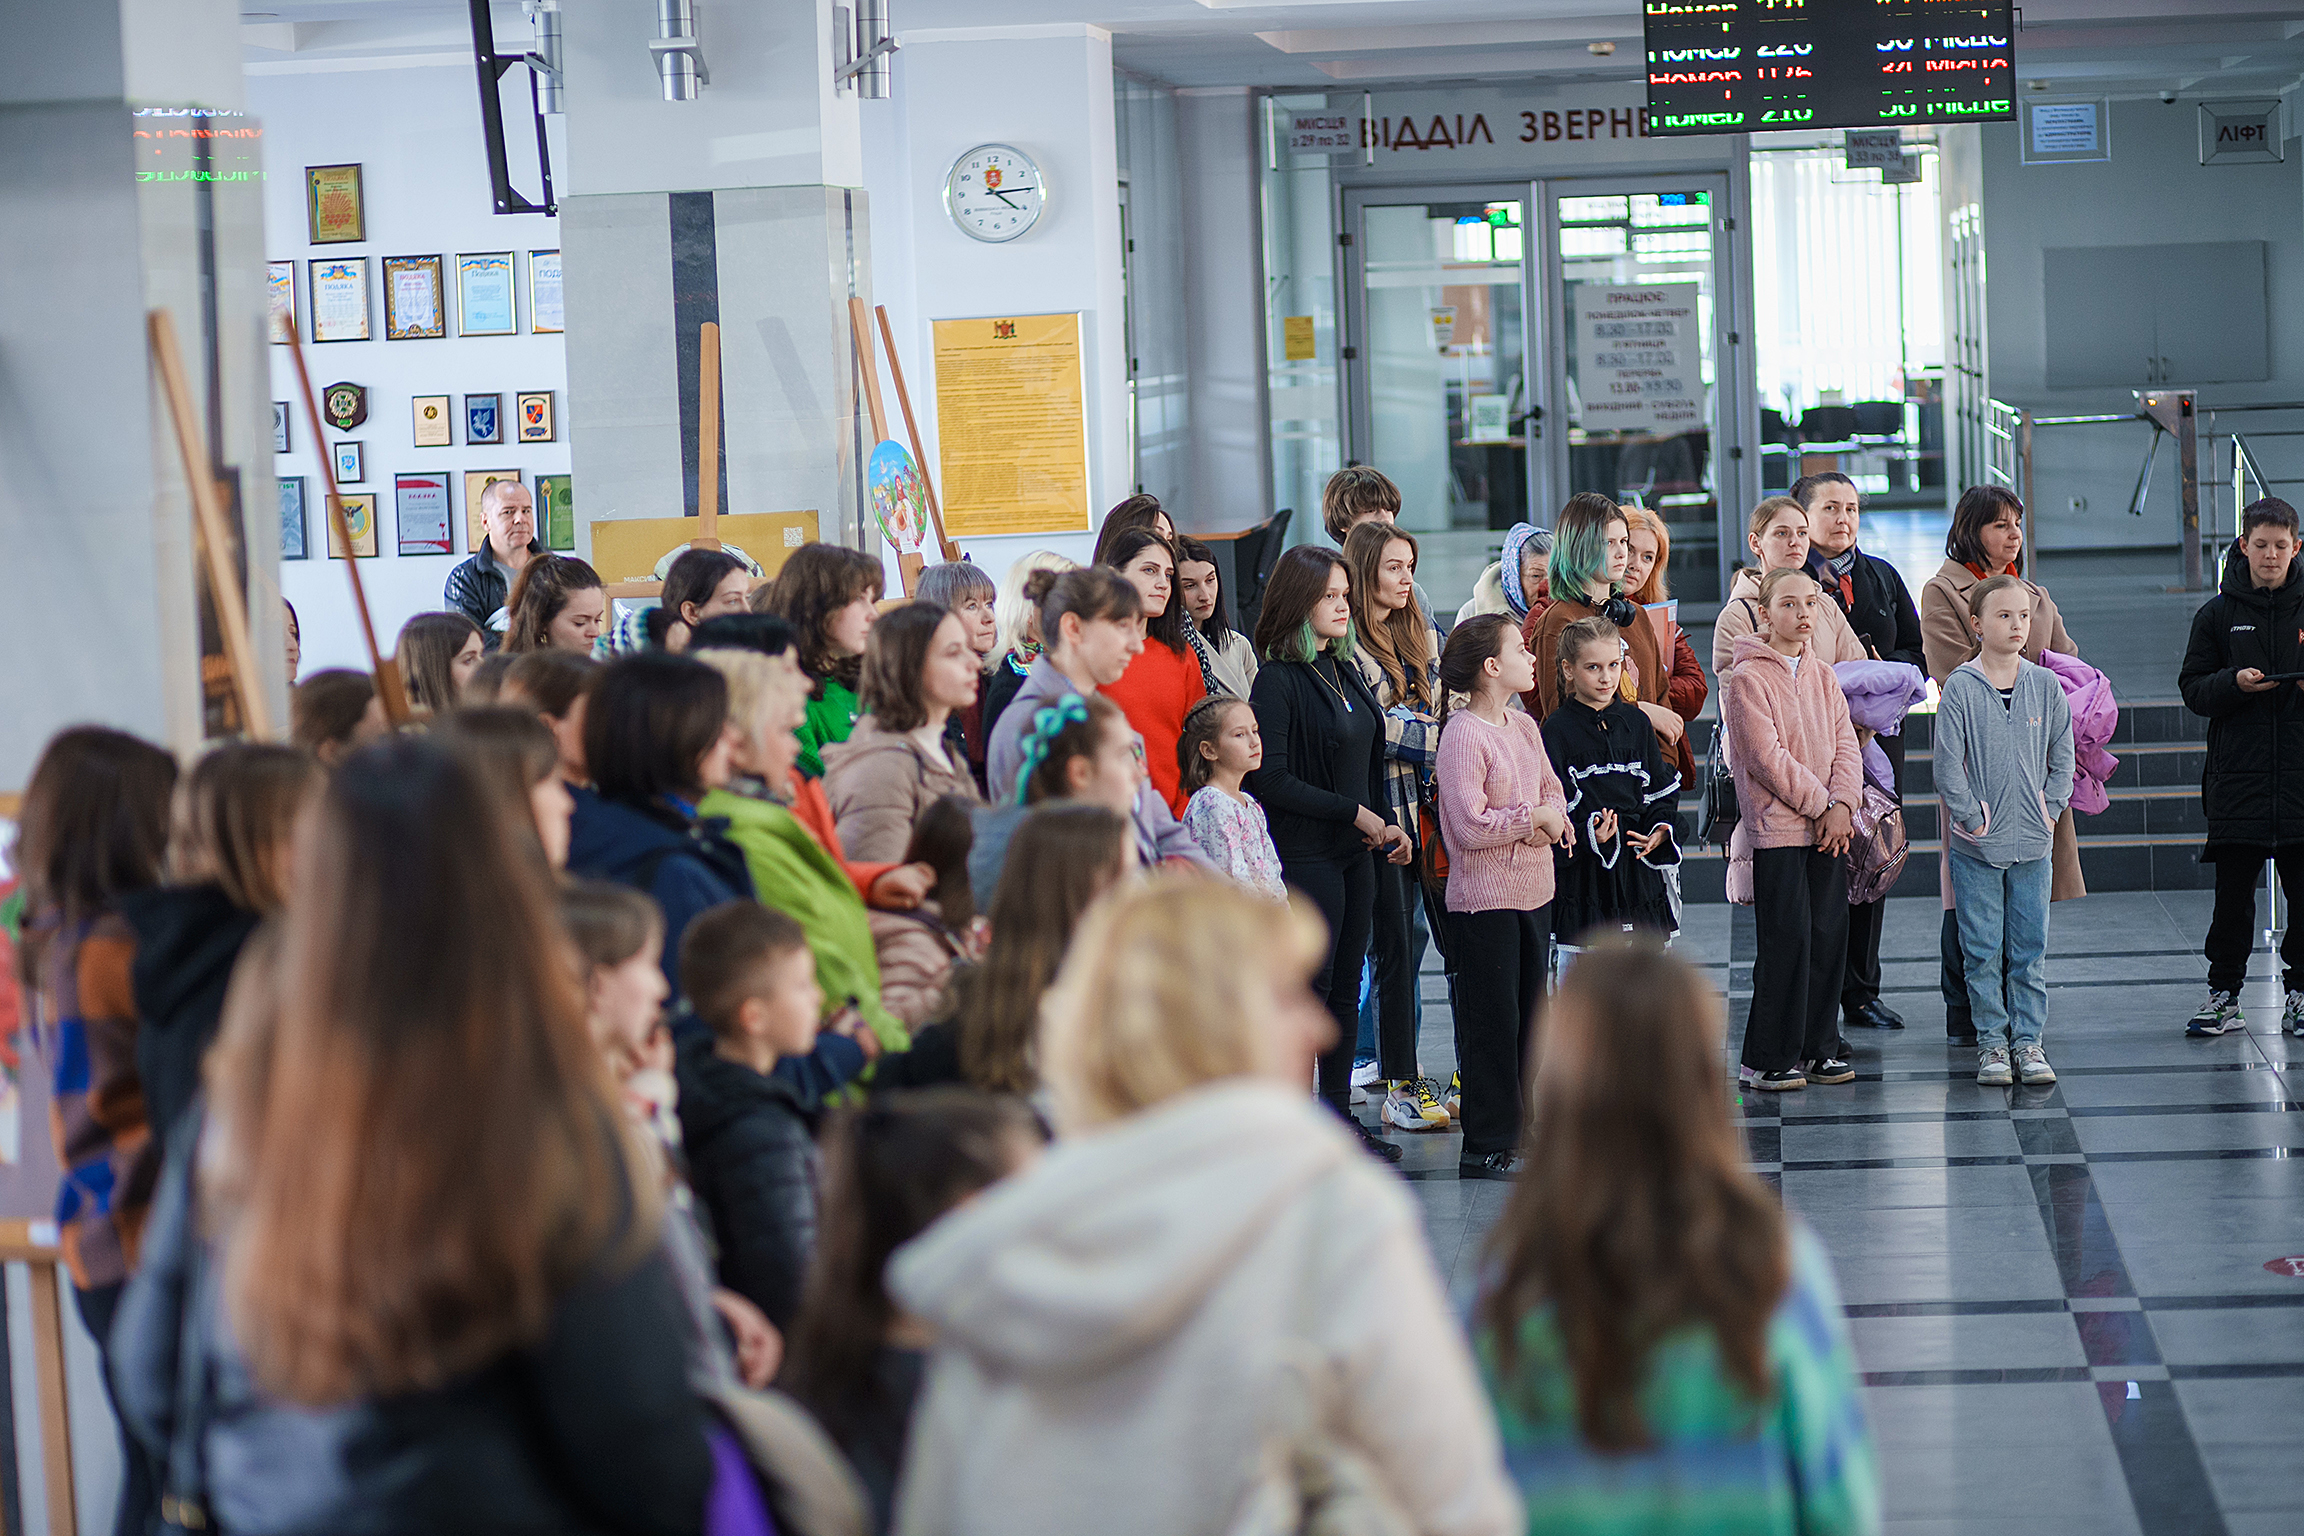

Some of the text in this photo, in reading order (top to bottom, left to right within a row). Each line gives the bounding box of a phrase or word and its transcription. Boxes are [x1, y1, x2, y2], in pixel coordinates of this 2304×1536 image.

[1360, 112, 1494, 151] ВІДДІЛ
[2218, 124, 2266, 142] ЛІФТ
[987, 155, 1000, 164] 12
[961, 174, 971, 182] 10
[1019, 170, 1026, 178] 2
[958, 191, 966, 199] 9
[963, 208, 972, 216] 8
[977, 219, 984, 227] 7
[1011, 216, 1018, 225] 5
[993, 222, 1001, 230] 6
[399, 273, 426, 281] ПОДЯКА
[324, 283, 354, 291] ПОДЯКА
